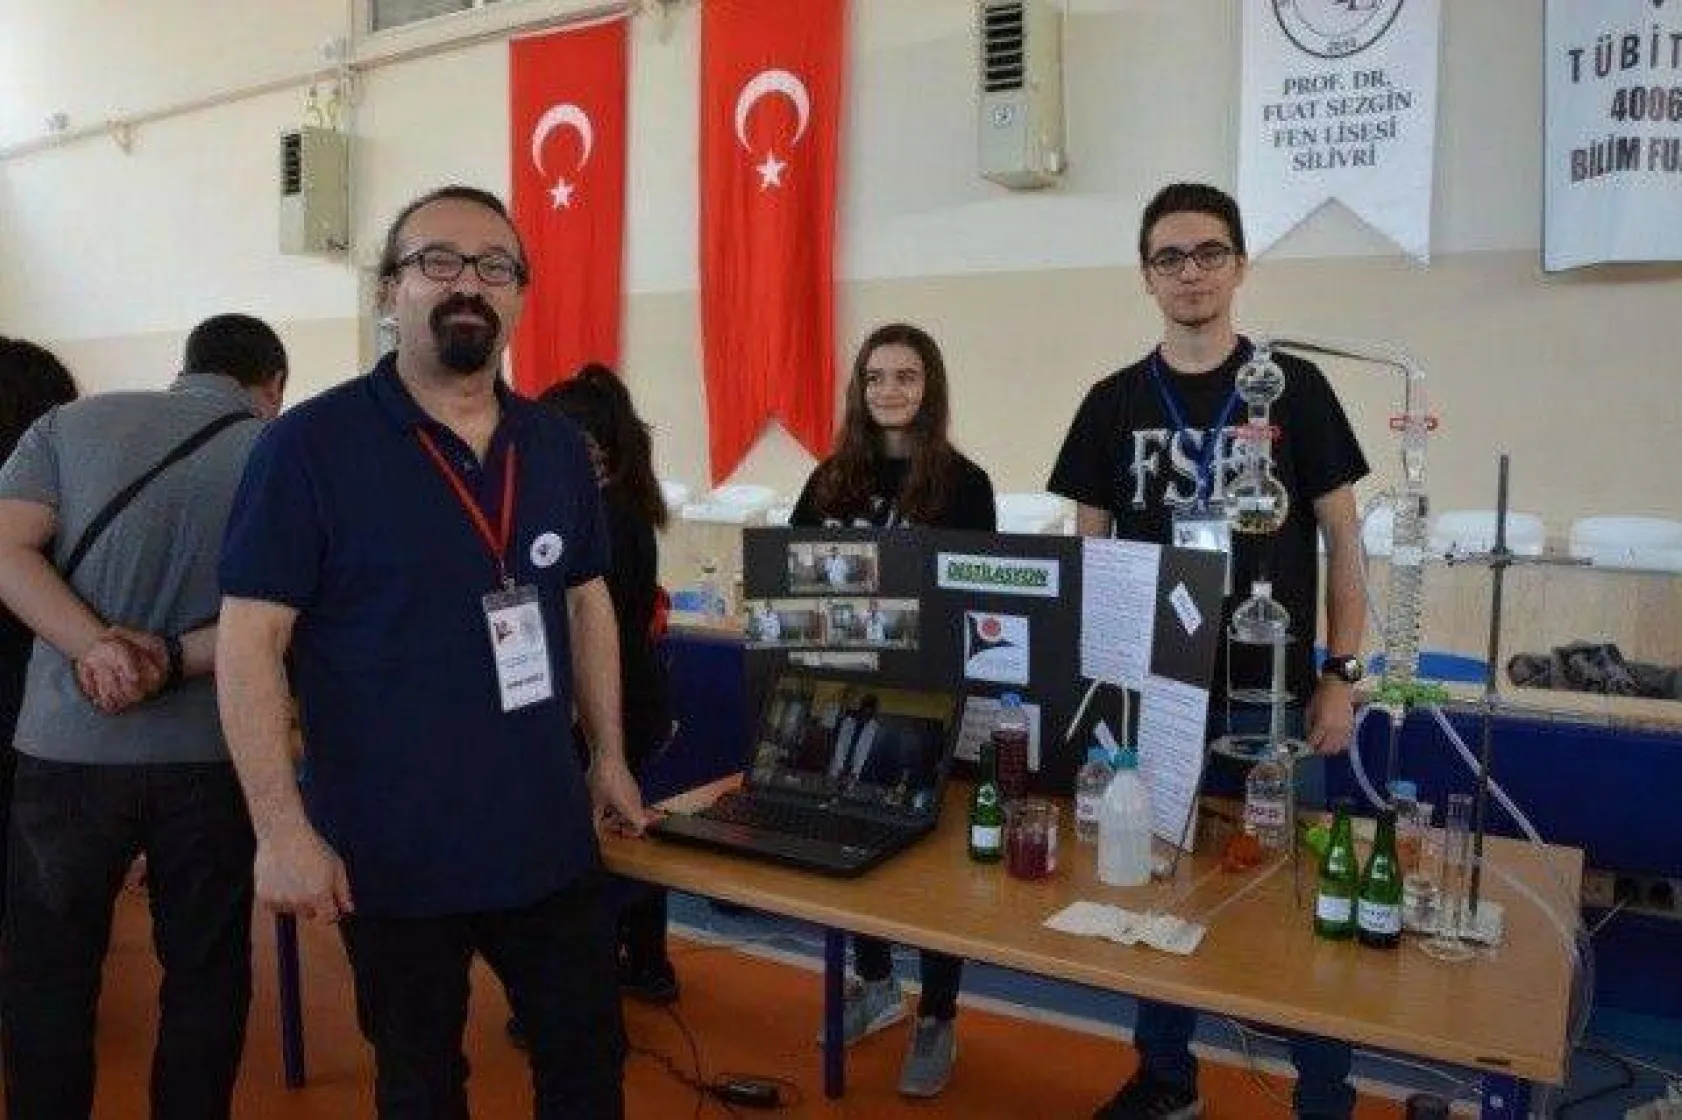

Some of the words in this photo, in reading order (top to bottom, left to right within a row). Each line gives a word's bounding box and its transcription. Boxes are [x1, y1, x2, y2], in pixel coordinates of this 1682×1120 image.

[1283, 74, 1345, 95] PROF.
[1352, 70, 1391, 90] DR.
[1262, 99, 1318, 122] FUAT
[1326, 91, 1412, 118] SEZGİN
[1611, 86, 1682, 122] 4006
[1273, 127, 1317, 148] FEN
